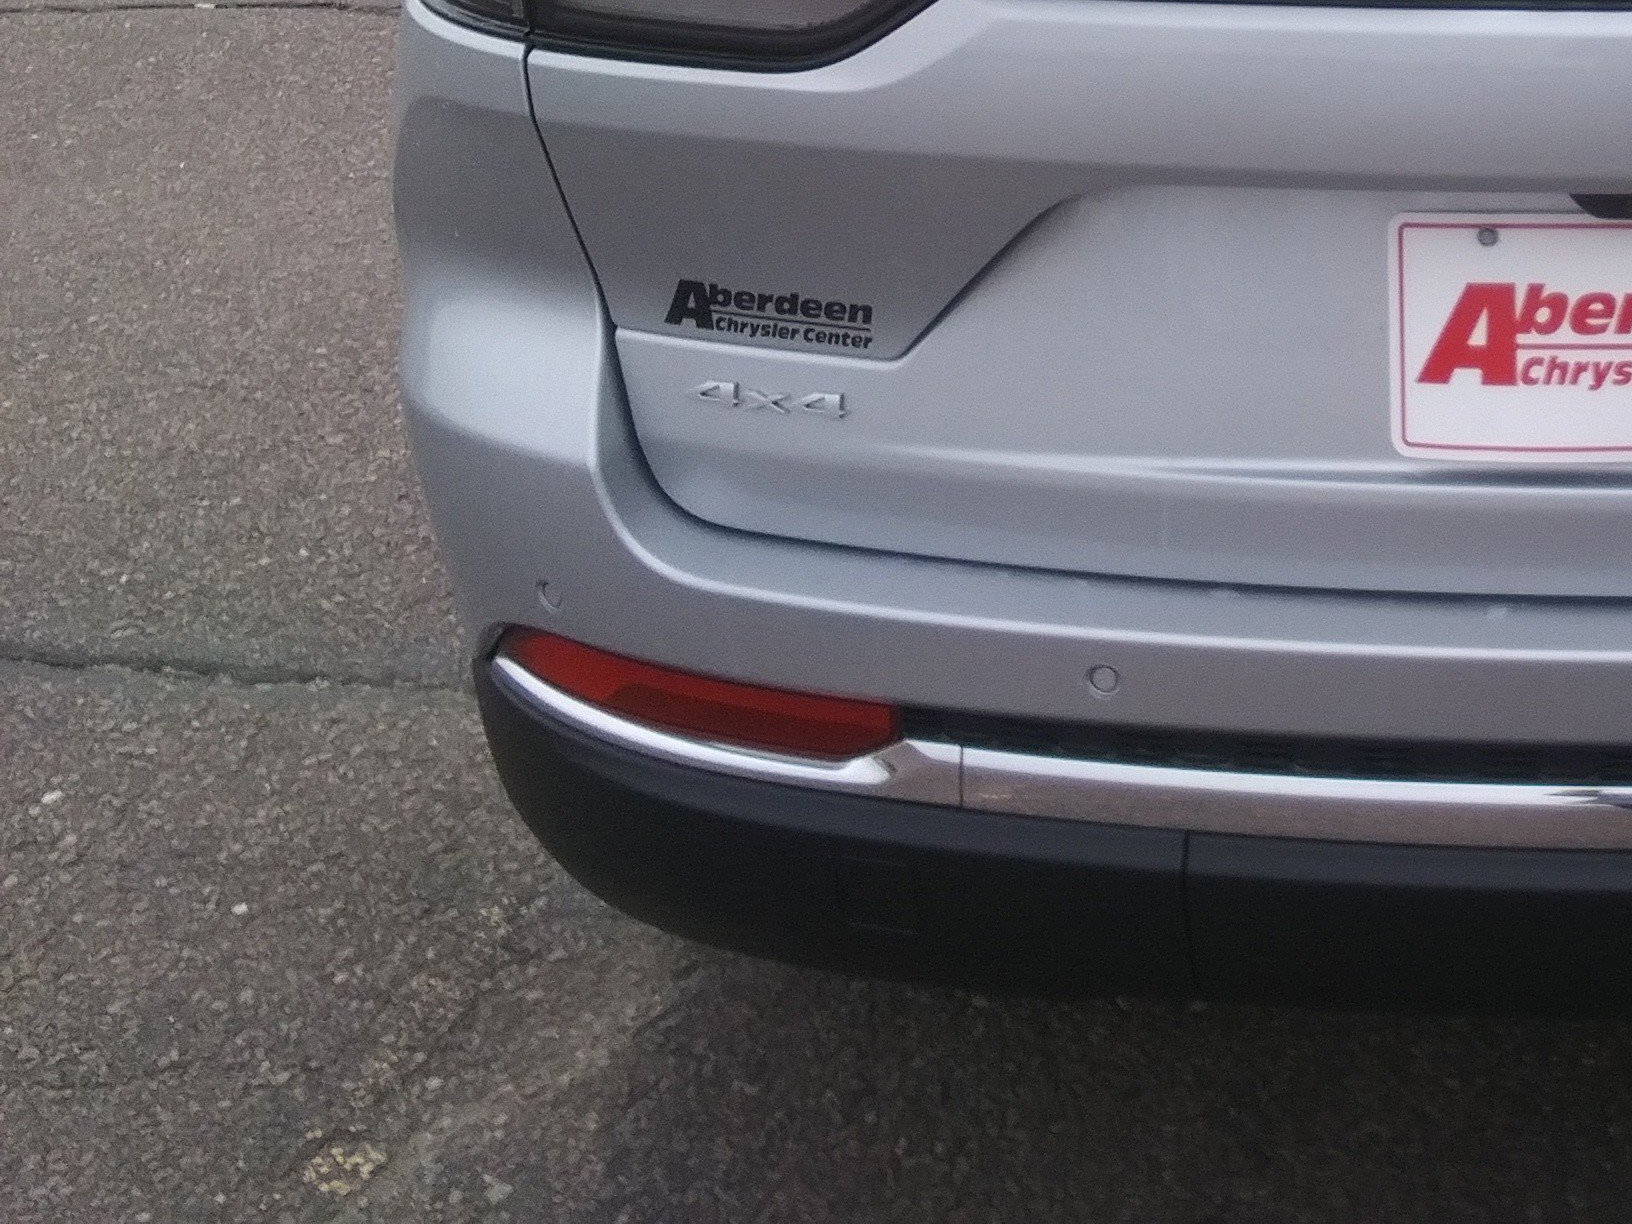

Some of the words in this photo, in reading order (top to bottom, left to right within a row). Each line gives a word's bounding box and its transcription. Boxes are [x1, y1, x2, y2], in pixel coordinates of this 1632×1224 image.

[664, 279, 873, 330] Aberdeen
[715, 315, 801, 340] Chrysler
[803, 328, 873, 349] Center
